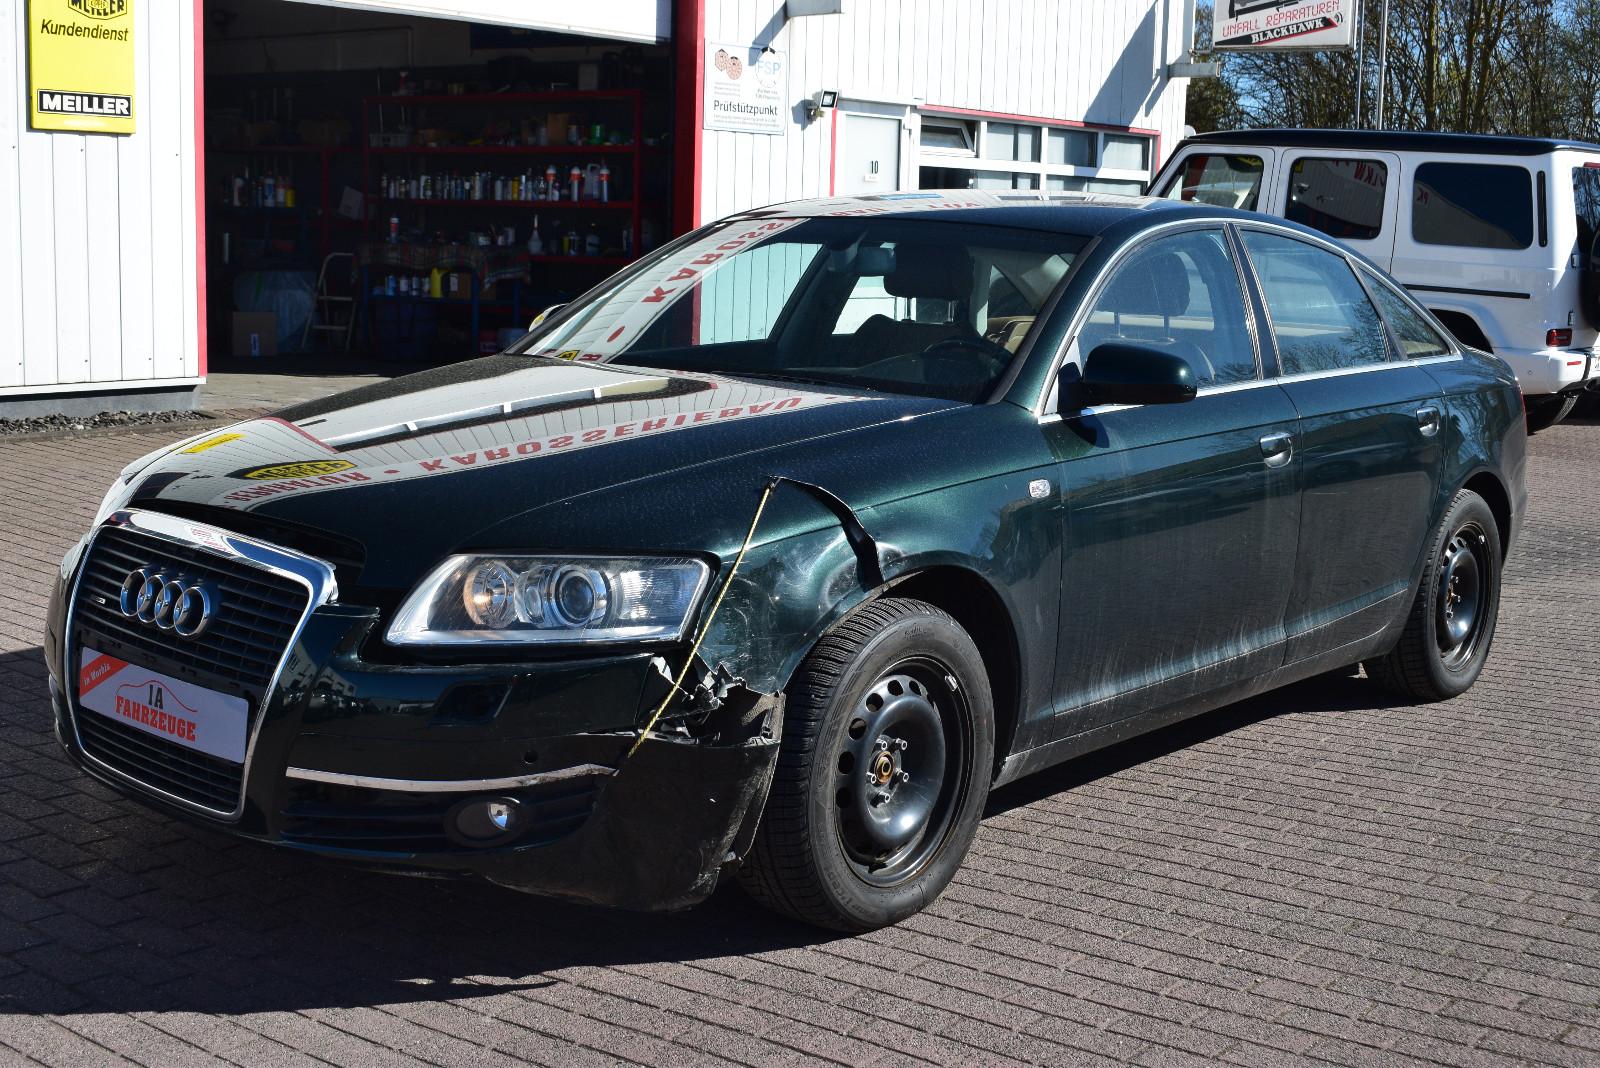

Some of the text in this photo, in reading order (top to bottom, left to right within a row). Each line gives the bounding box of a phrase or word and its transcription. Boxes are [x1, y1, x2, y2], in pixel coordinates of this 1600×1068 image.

[41, 19, 128, 41] Kundendienst
[1222, 18, 1260, 38] UNFALL
[1251, 17, 1325, 44] BLACKHAWK
[42, 93, 129, 115] MEILLER
[713, 99, 778, 116] Prüfstützpunkt
[870, 160, 879, 174] 10
[115, 695, 196, 742] FAHRZEUGE
